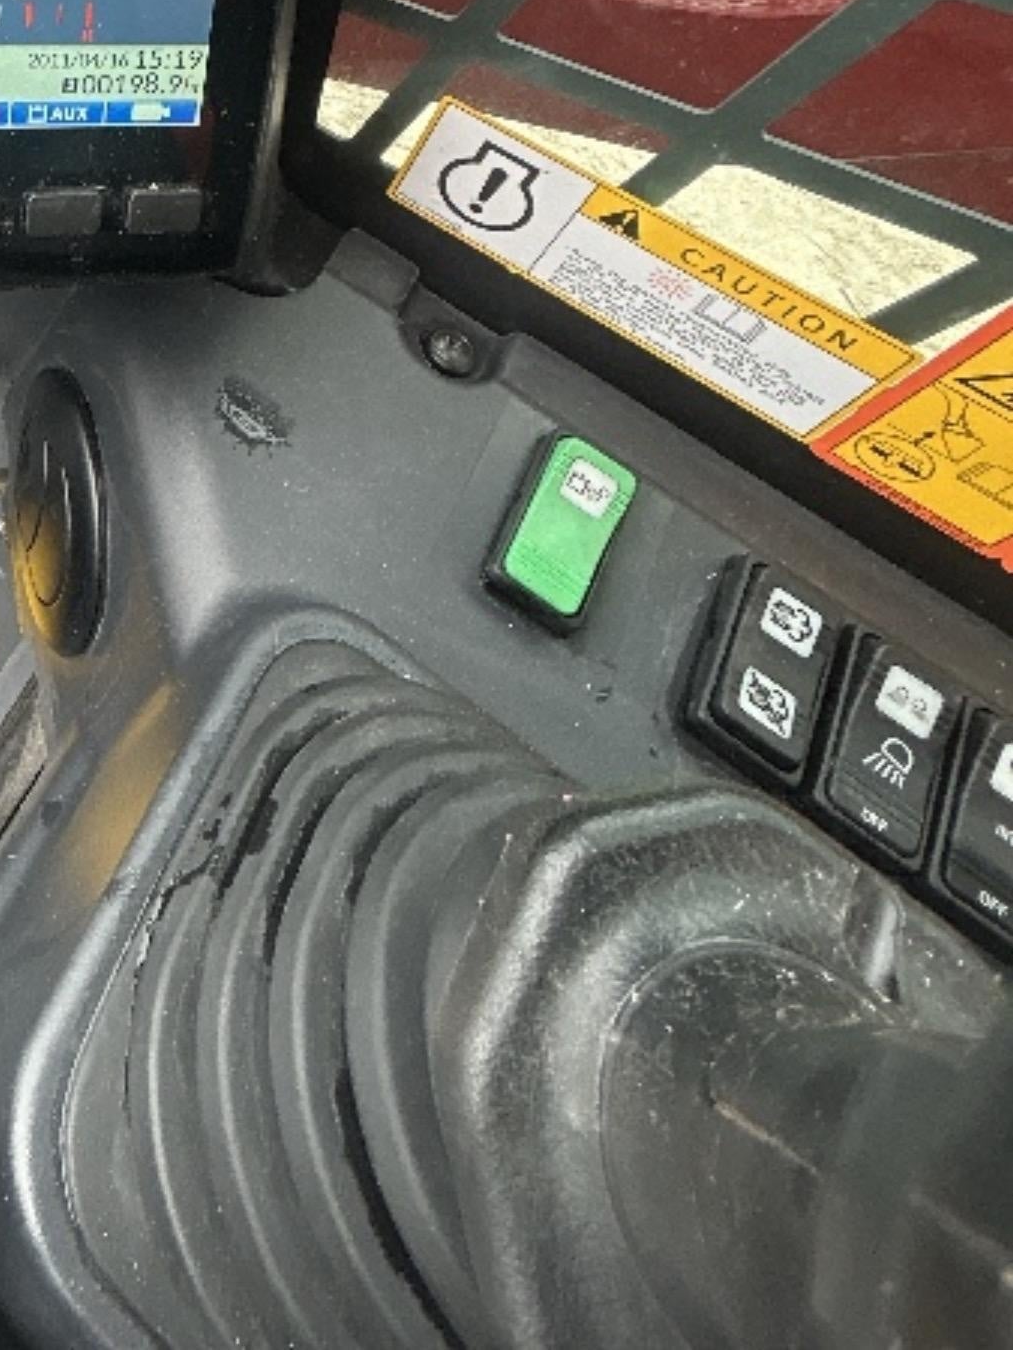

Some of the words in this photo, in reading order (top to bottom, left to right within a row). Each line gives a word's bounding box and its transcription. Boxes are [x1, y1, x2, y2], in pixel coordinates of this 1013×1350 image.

[135, 50, 204, 70] 15:19
[49, 105, 88, 122] AUX
[679, 247, 859, 352] CAUTION
